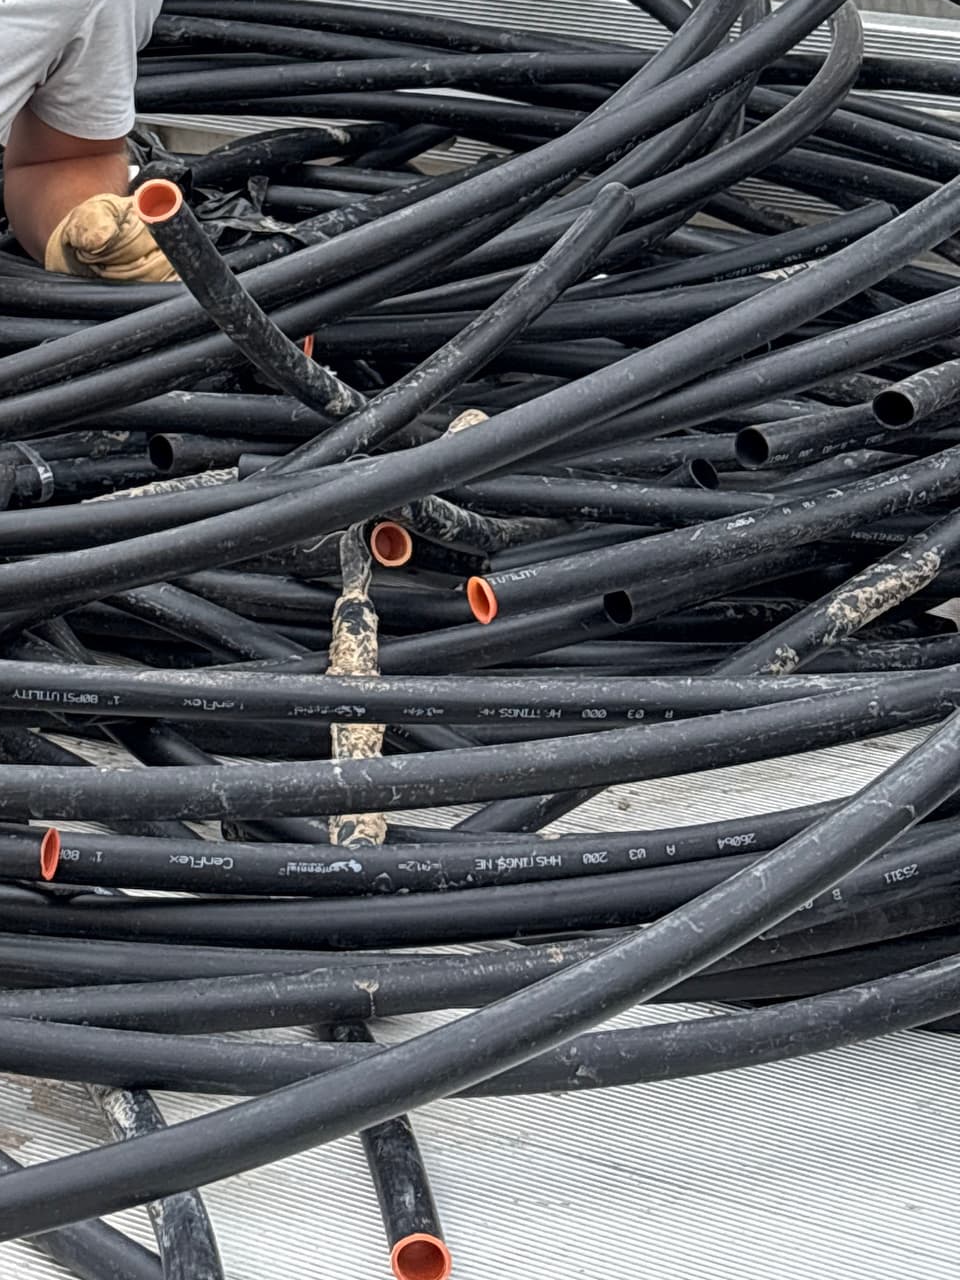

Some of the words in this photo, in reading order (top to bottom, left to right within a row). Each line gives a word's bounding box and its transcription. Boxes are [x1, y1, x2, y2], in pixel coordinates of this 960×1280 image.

[12, 688, 60, 702] UTILITY
[168, 854, 234, 870] CenFlex
[882, 863, 920, 884] 25311
